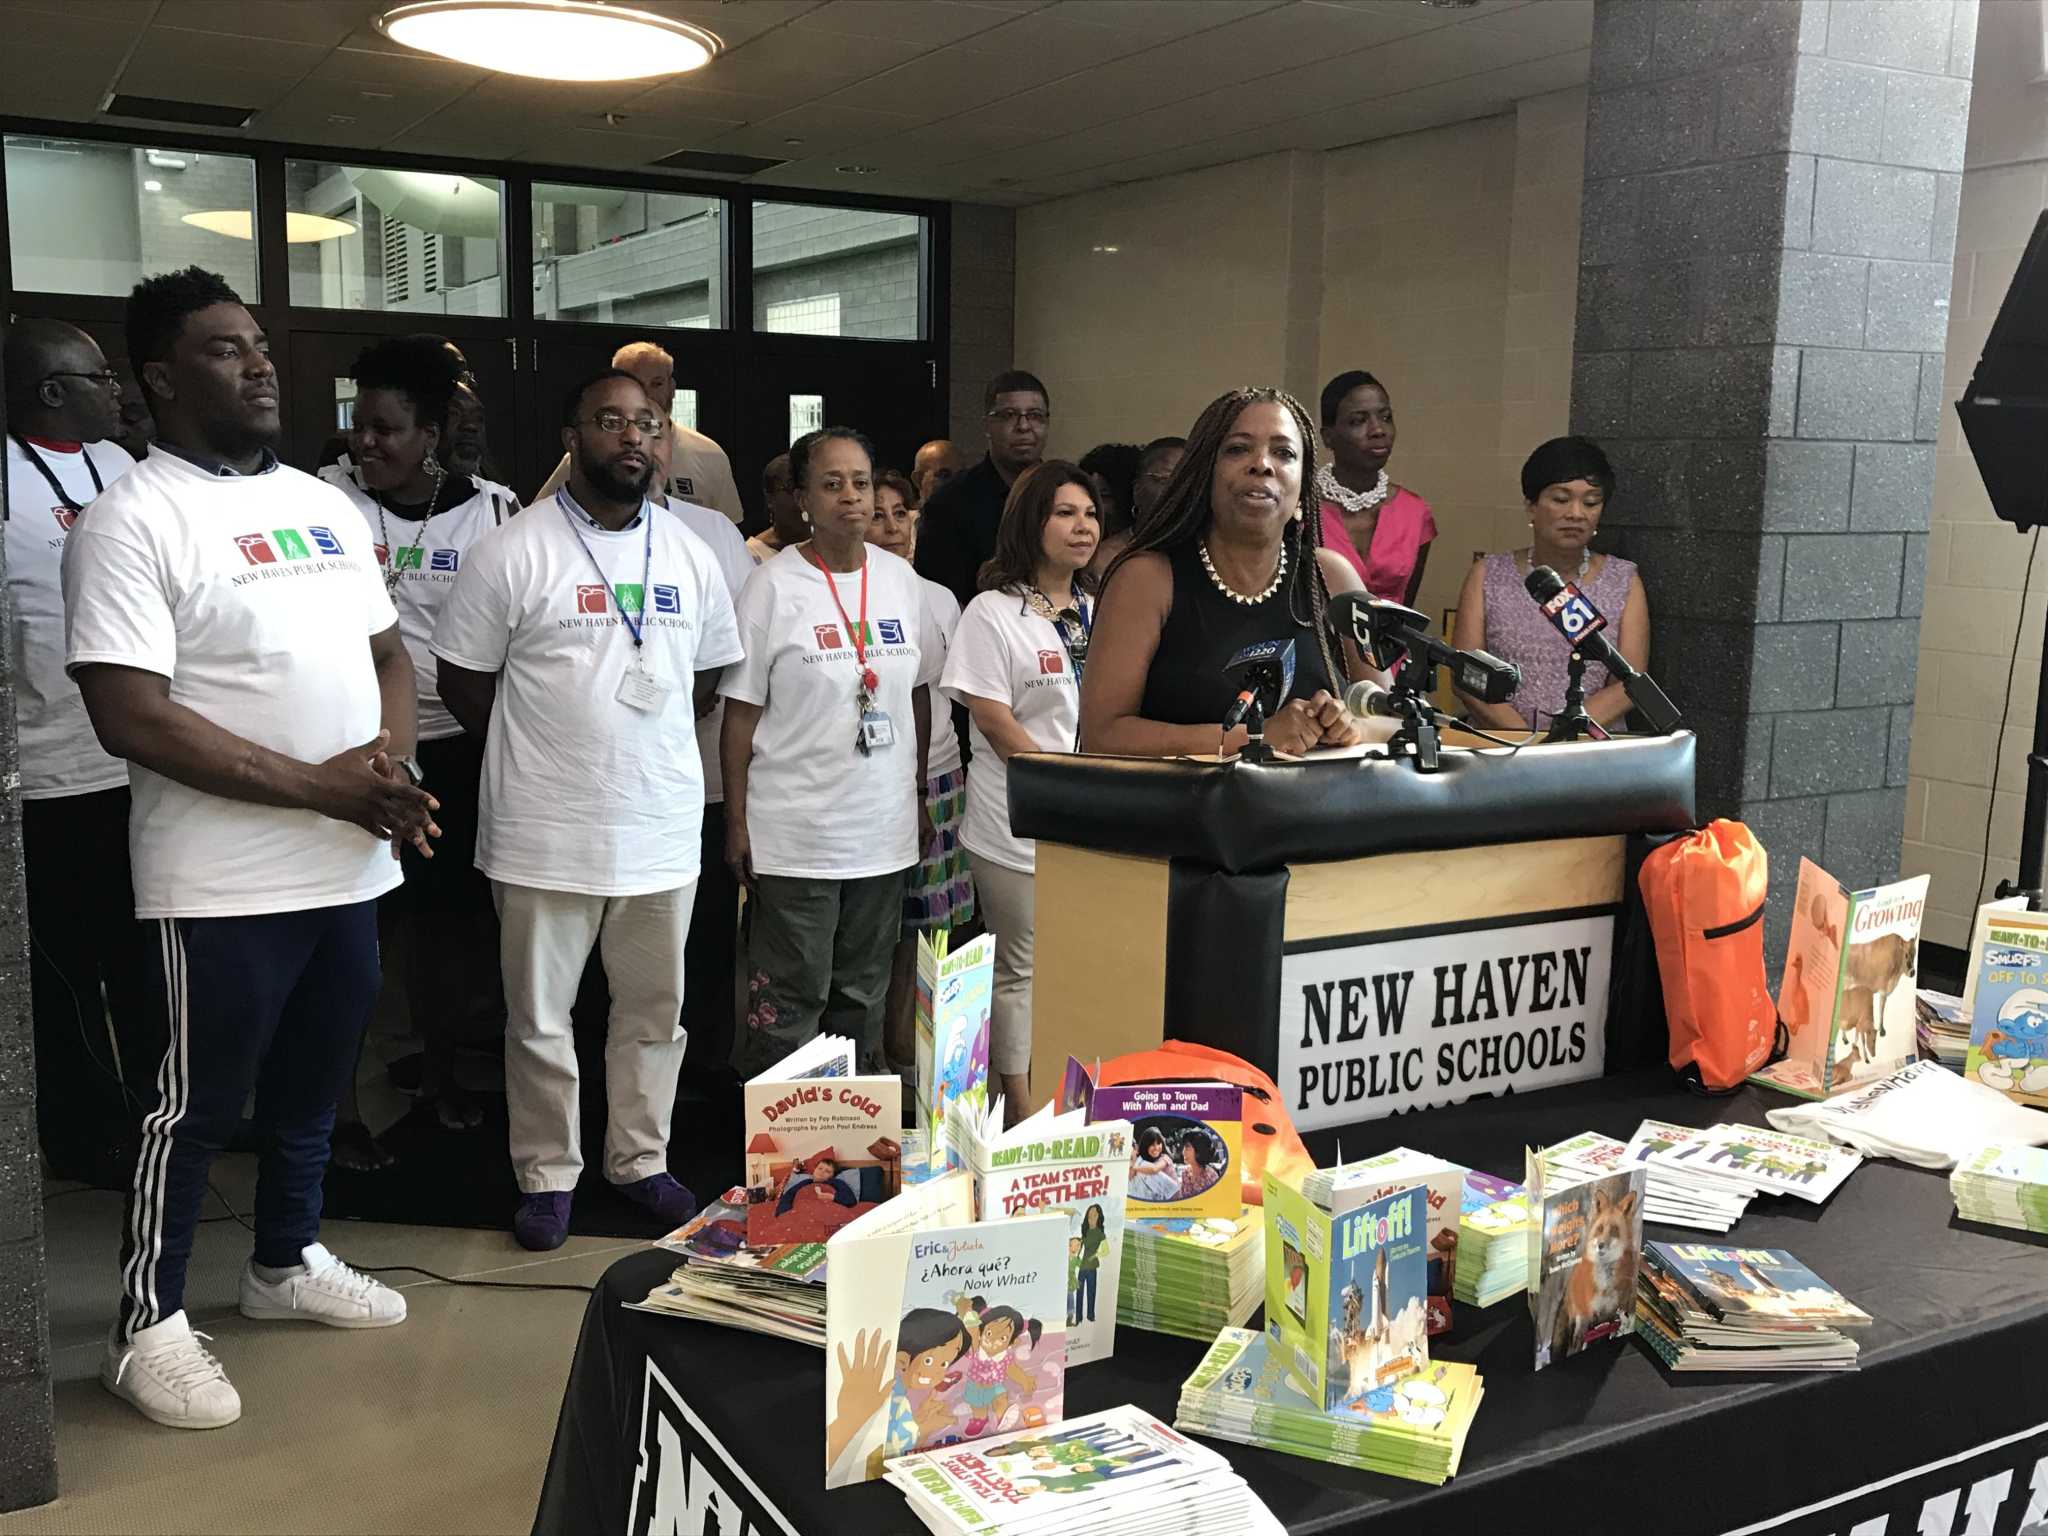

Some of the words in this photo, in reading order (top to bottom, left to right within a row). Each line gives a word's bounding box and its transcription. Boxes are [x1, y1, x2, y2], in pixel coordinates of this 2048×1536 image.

[232, 572, 259, 587] NEW
[261, 567, 294, 580] HAVEN
[293, 561, 326, 576] PUBLIC
[400, 572, 429, 581] UBLIC
[1546, 588, 1576, 614] FOX
[559, 618, 582, 630] NEW
[586, 616, 619, 628] HAVEN
[621, 616, 657, 627] PBLIC
[1352, 602, 1371, 645] CT
[1562, 598, 1595, 632] 61
[802, 654, 824, 665] NEW
[826, 651, 854, 661] HAVEN
[1249, 646, 1276, 657] 1220
[1024, 679, 1045, 689] NEW
[1046, 677, 1072, 686] HAVEN
[1855, 897, 1923, 933] Growing
[1988, 971, 2016, 984] OFF
[2018, 971, 2037, 985] TO
[1300, 970, 1415, 1049] NEW
[1431, 946, 1592, 1029] HAVEN
[1298, 1047, 1424, 1111] PUBLIC
[1436, 1021, 1587, 1087] SCHOOLS
[761, 1086, 833, 1122] David's
[838, 1088, 882, 1119] Cold
[1122, 1101, 1142, 1111] With
[1145, 1101, 1167, 1111] Mom
[1170, 1101, 1187, 1111] and
[1190, 1101, 1209, 1111] Dad
[1133, 1091, 1159, 1102] Going
[1162, 1092, 1172, 1101] to
[1174, 1091, 1198, 1101] Town
[769, 1125, 809, 1133] Photographs
[810, 1124, 818, 1132] by
[819, 1123, 835, 1131] John
[785, 1115, 808, 1124] Written
[809, 1115, 818, 1124] by
[1051, 1135, 1100, 1159] READ
[1011, 1179, 1020, 1192] A
[1023, 1170, 1060, 1189] TEAM
[1062, 1164, 1103, 1182] STAYS
[1002, 1176, 1109, 1215] TOGETHER!
[1342, 1193, 1412, 1260] Liftoff!
[914, 1241, 941, 1259] Eric
[921, 1263, 974, 1283] ¿Ahora
[978, 1256, 1011, 1277] qué?
[963, 1279, 993, 1290] Now
[997, 1271, 1038, 1287] What?
